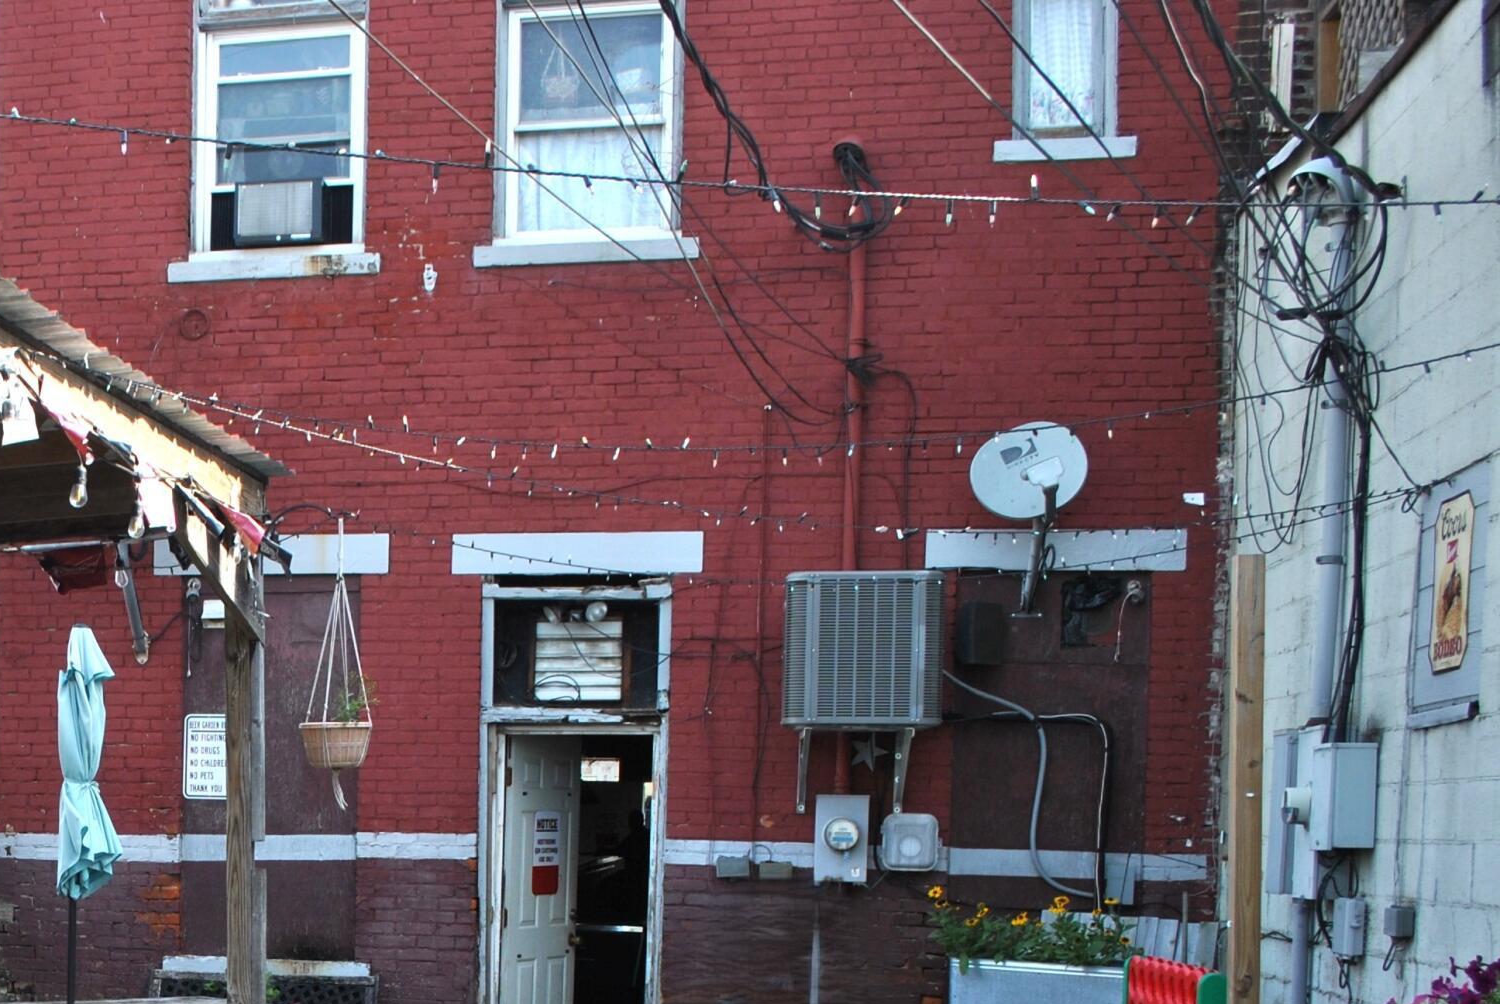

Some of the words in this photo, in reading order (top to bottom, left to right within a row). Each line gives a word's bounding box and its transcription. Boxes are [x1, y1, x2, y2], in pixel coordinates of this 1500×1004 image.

[189, 720, 200, 729] BEER
[202, 720, 219, 729] GARDEN
[190, 733, 198, 741] NO
[190, 746, 198, 754] NO
[201, 746, 220, 754] DRUGS
[190, 759, 198, 767] NO
[190, 771, 198, 780] NO
[200, 771, 214, 780] PETS
[189, 784, 208, 793] THANK
[211, 784, 222, 793] YOU
[536, 818, 558, 829] NOTICE
